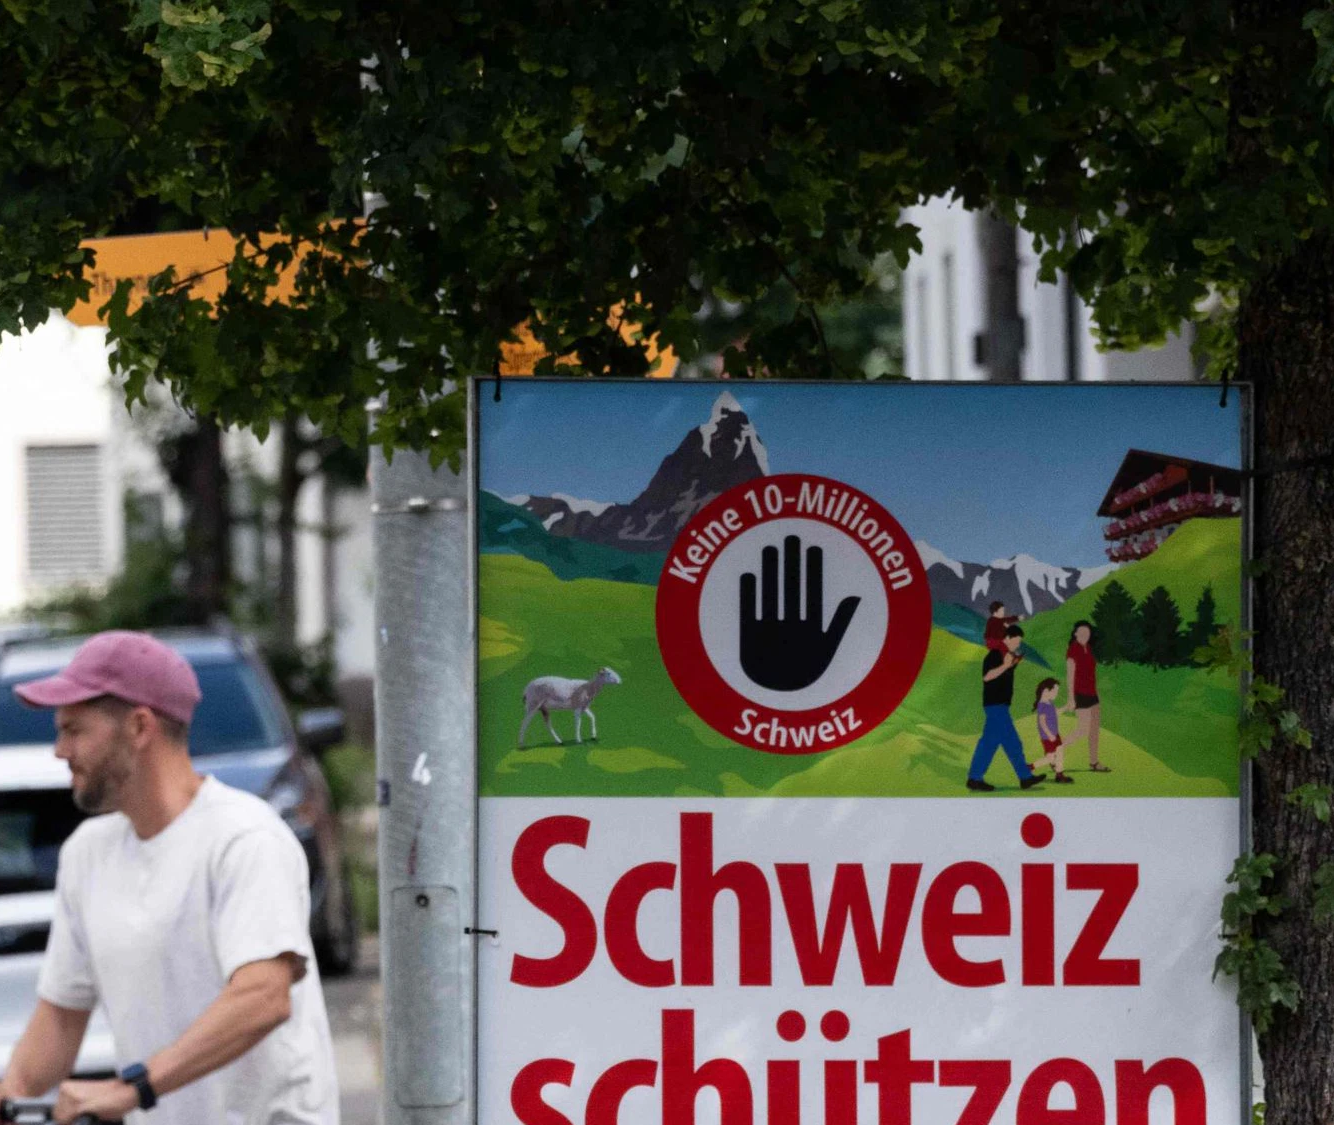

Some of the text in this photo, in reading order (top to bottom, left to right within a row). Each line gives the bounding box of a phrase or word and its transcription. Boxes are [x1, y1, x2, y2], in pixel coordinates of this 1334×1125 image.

[669, 482, 914, 590] Keine 10-Millionen
[733, 704, 863, 748] Schweiz
[510, 811, 1141, 988] Schweiz
